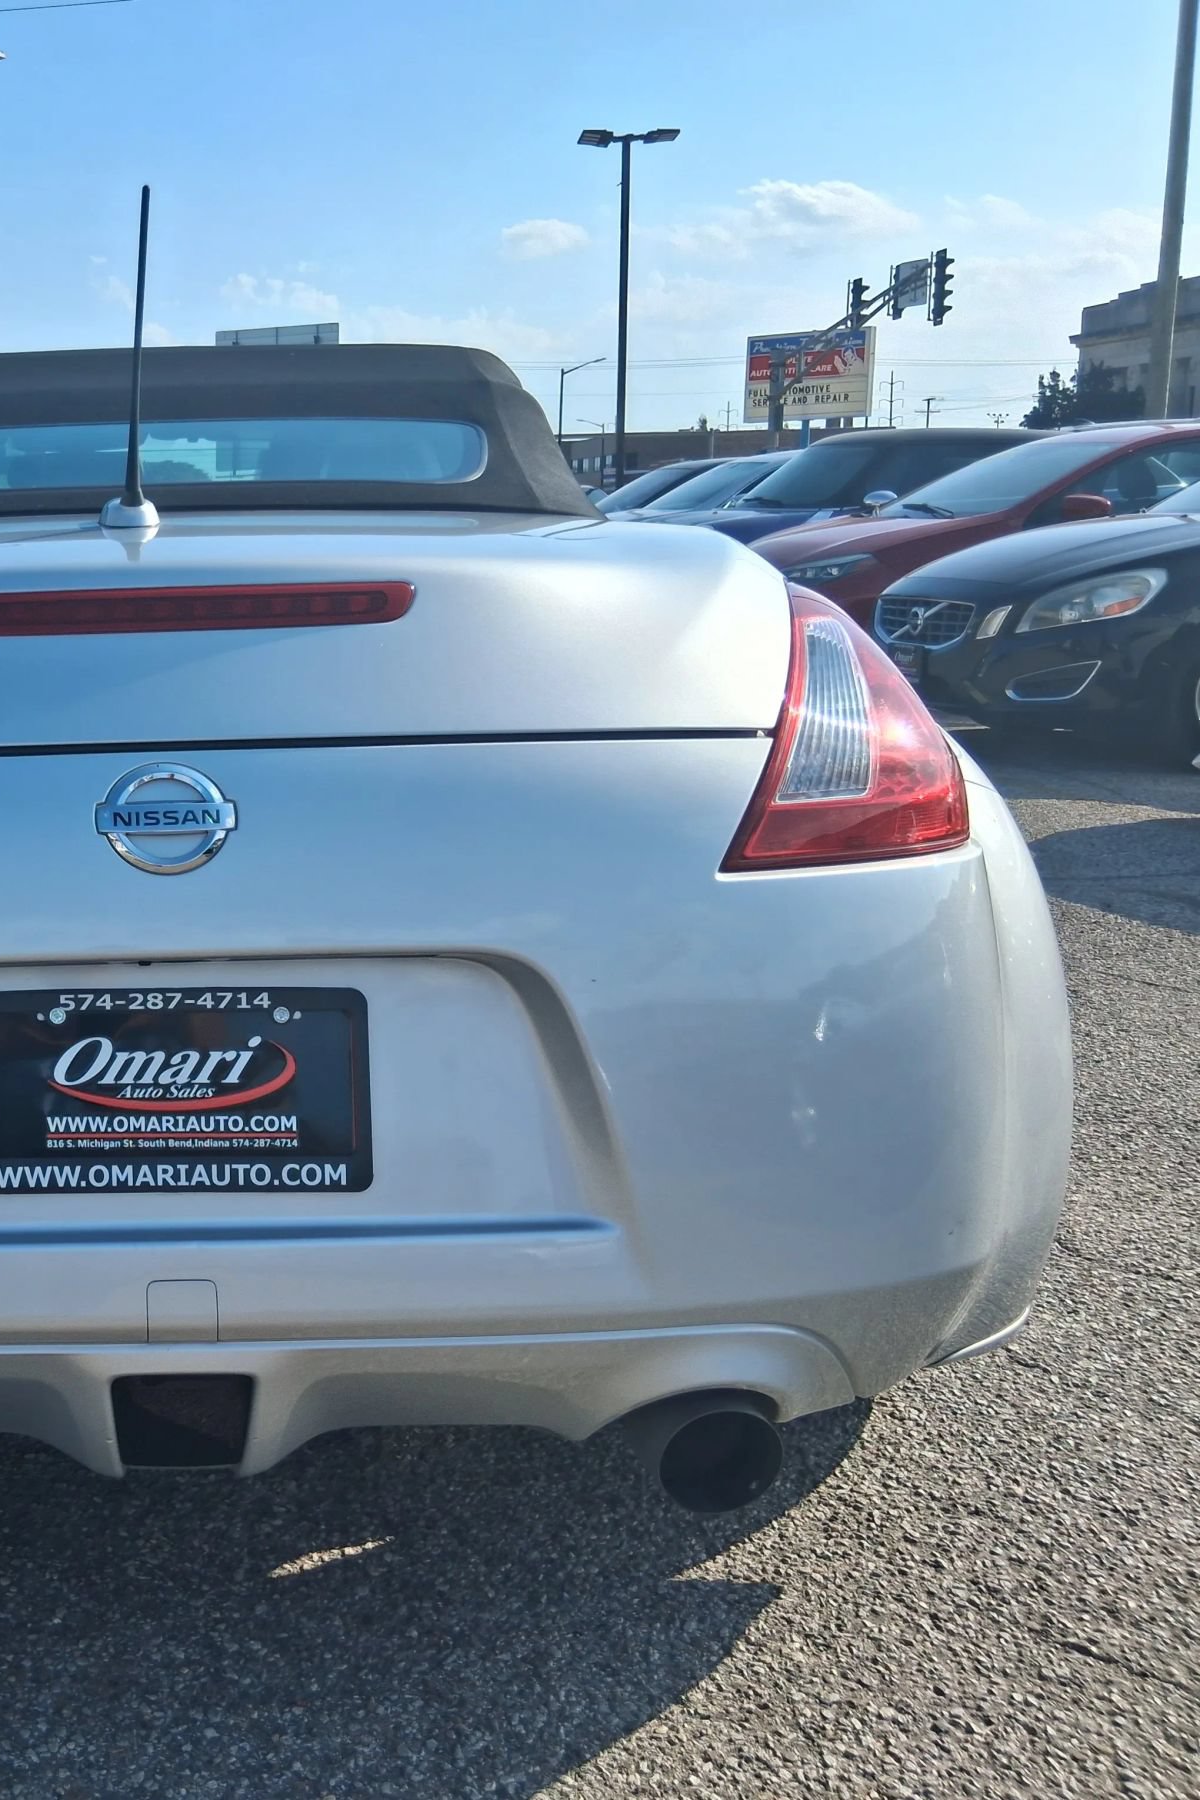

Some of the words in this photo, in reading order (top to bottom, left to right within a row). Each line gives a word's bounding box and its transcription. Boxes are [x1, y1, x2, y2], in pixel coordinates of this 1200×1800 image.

[748, 388, 769, 398] FULL
[752, 397, 788, 407] SERE
[792, 396, 808, 405] AND
[815, 393, 849, 403] REPAIR
[112, 809, 221, 827] NISSAN
[58, 991, 272, 1011] 574-287-4714
[52, 1035, 262, 1086] Omari
[116, 1084, 164, 1099] Auto
[165, 1083, 216, 1099] Sales
[46, 1115, 298, 1133] WWW.OMARIAUTO.COM
[46, 1139, 65, 1149] 816
[66, 1139, 76, 1149] S.
[77, 1138, 121, 1151] Michigan
[123, 1139, 136, 1149] St.
[137, 1138, 166, 1149] South
[232, 1138, 298, 1149] 574-287-4714
